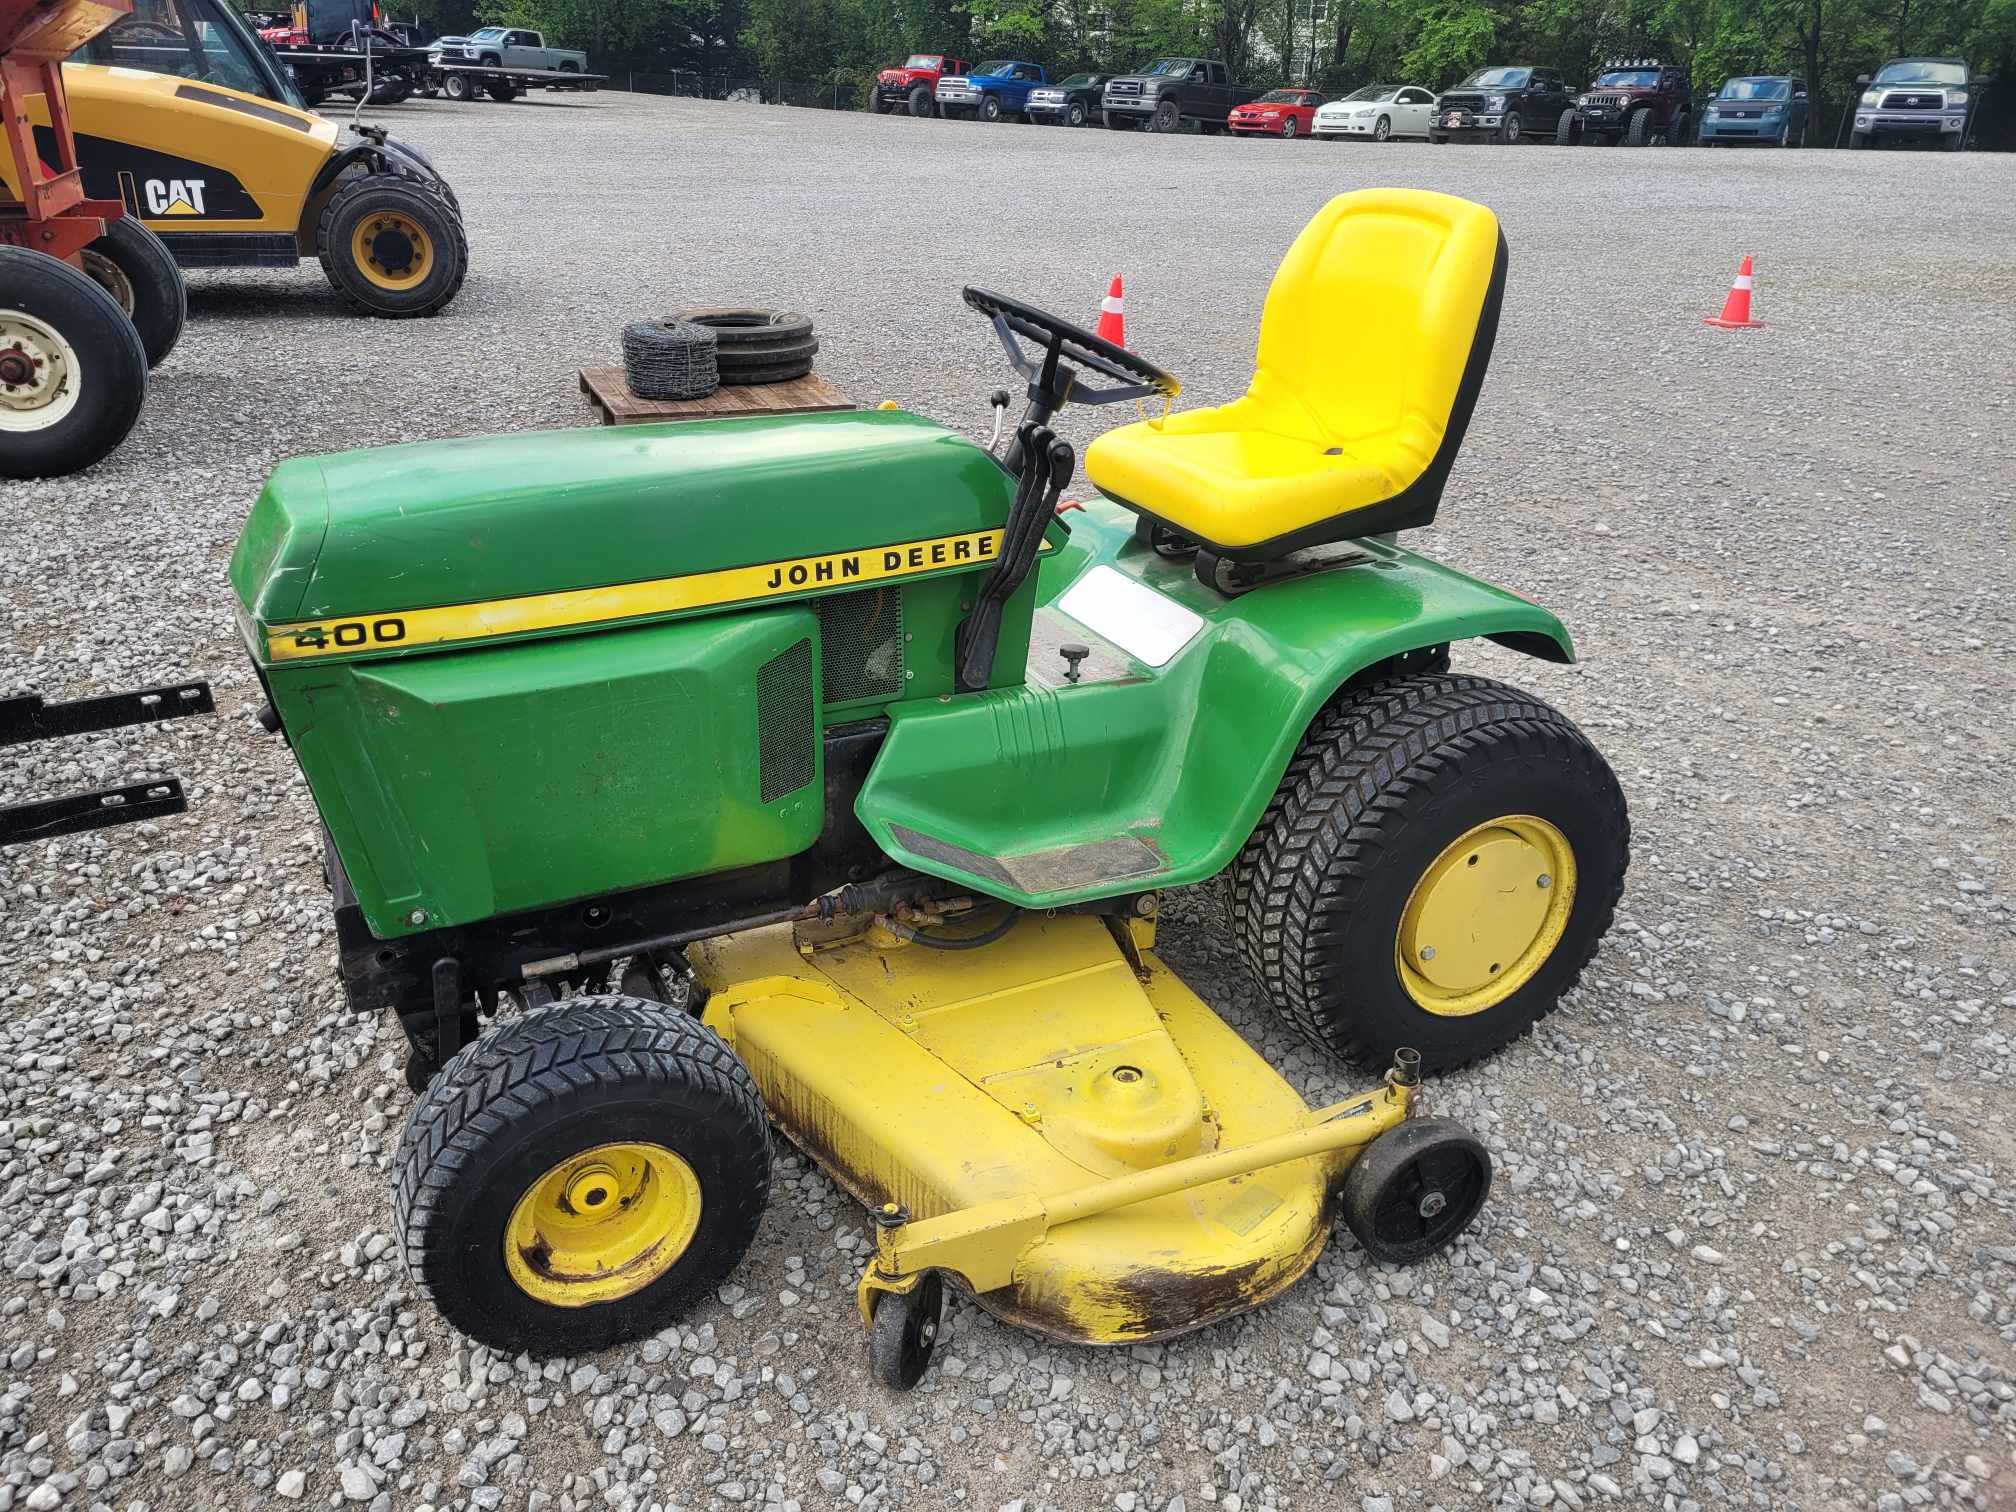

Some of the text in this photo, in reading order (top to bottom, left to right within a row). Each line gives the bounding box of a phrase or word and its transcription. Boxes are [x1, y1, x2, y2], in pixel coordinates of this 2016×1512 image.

[145, 179, 205, 215] CAT
[767, 536, 993, 589] JOHN DEERE
[294, 618, 406, 650] 400
